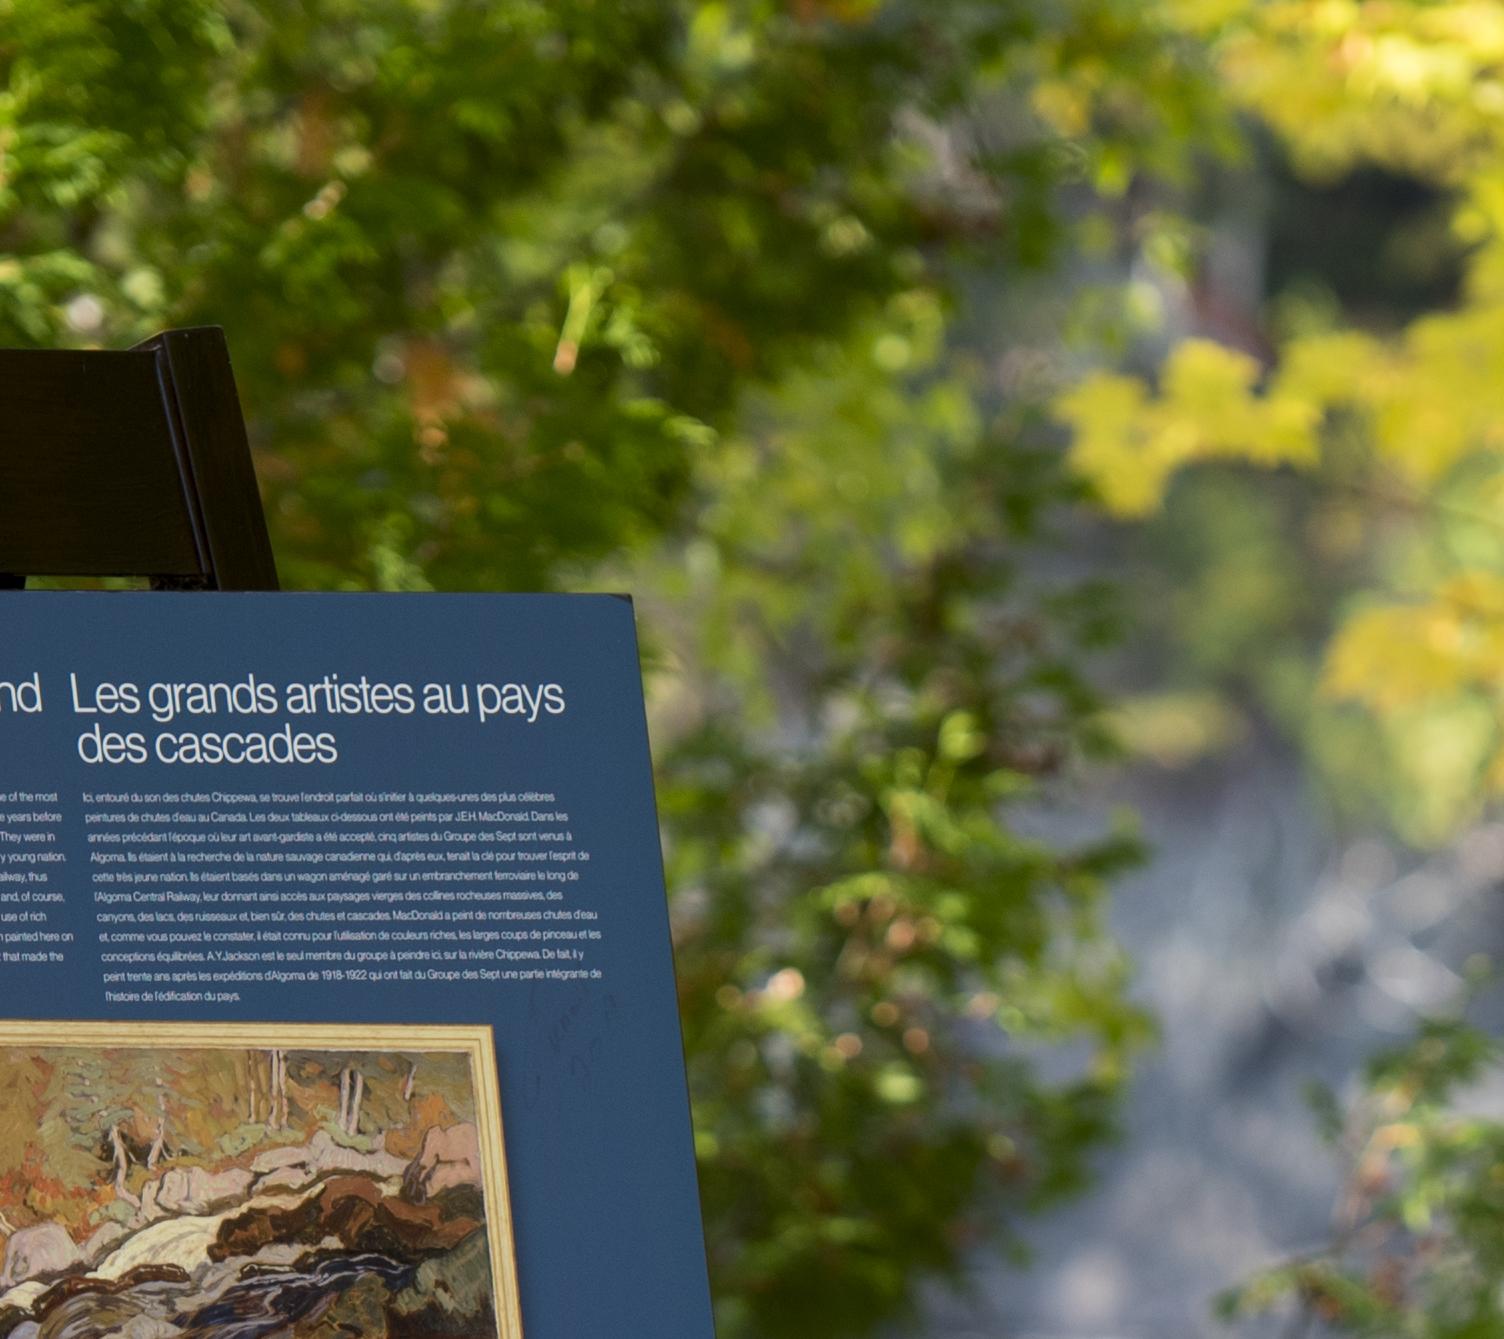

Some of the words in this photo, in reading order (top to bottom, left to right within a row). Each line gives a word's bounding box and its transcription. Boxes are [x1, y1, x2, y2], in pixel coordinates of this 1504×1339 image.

[70, 673, 140, 713] Les
[149, 674, 278, 722] grands
[286, 673, 415, 714] artistes
[423, 684, 469, 714] au
[477, 684, 565, 723] pays
[78, 723, 147, 763] des
[155, 723, 337, 763] cascades
[8, 791, 17, 802] of
[19, 792, 34, 802] the
[35, 792, 58, 802] most
[7, 813, 32, 824] years
[33, 811, 62, 822] before
